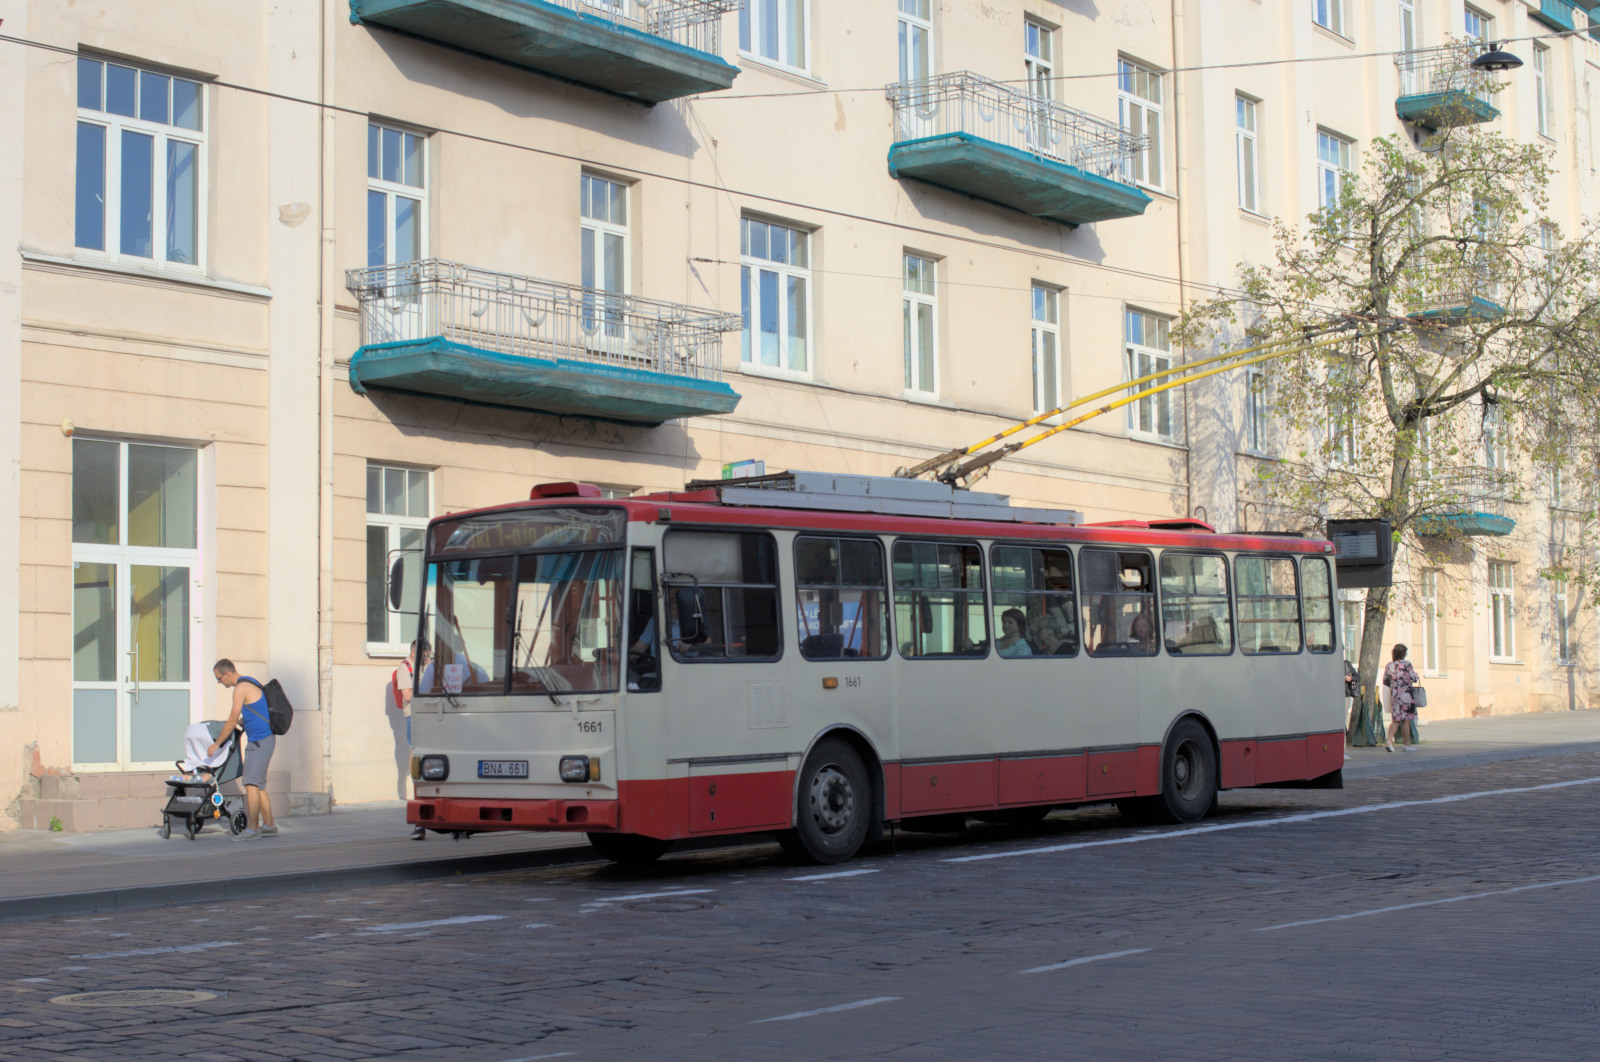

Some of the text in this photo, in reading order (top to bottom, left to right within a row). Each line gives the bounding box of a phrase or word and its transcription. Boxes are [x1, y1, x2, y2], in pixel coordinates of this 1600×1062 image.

[845, 676, 861, 687] 1661
[577, 721, 602, 732] 1661
[484, 763, 525, 774] BNA 661
